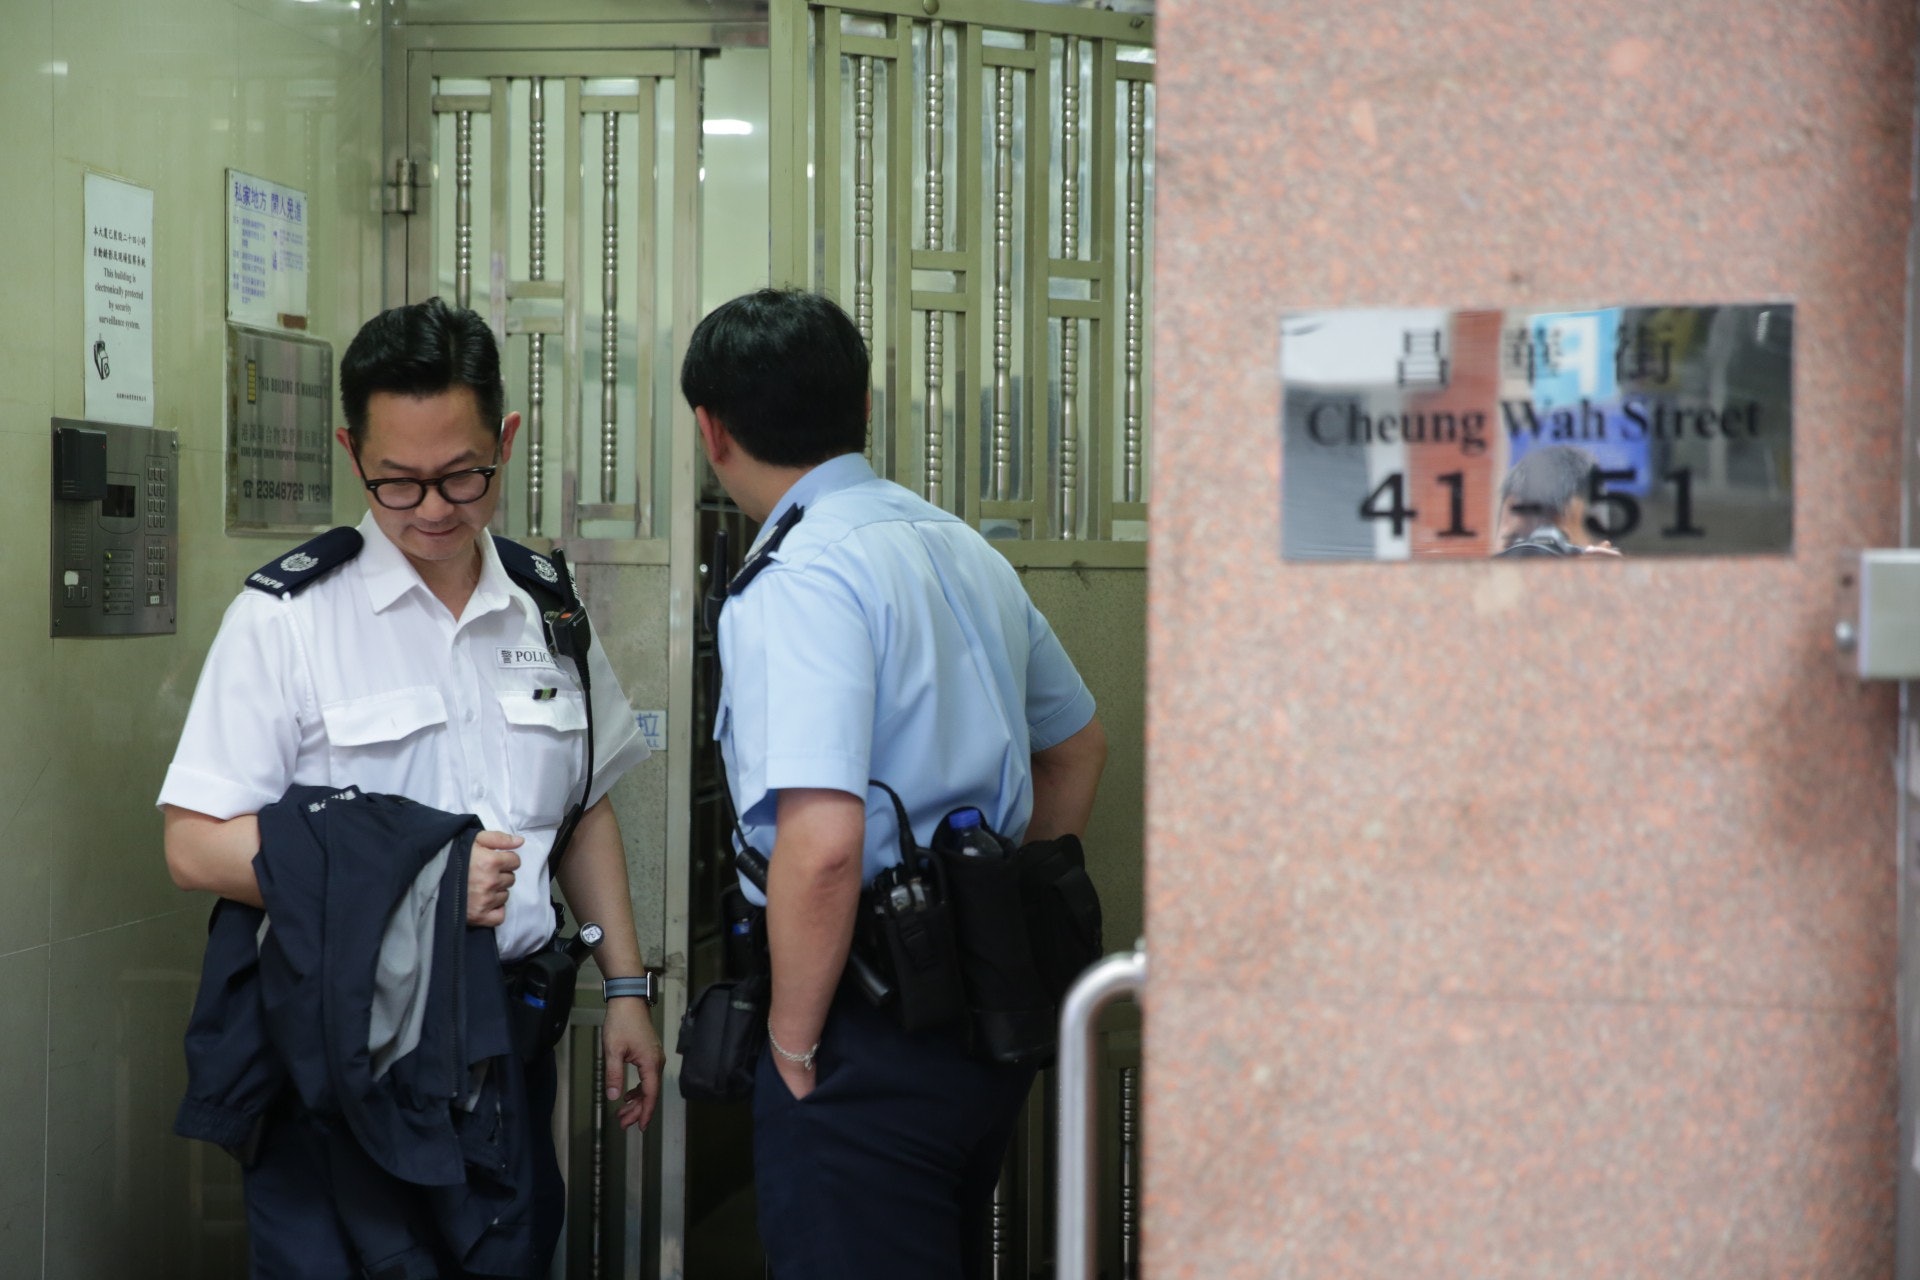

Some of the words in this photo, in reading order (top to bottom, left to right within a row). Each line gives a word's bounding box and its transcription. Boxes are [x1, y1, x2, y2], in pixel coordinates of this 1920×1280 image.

[234, 181, 267, 211] 私家地方
[103, 267, 114, 279] This
[114, 268, 132, 284] building
[132, 273, 136, 283] is
[94, 282, 125, 299] electronically
[124, 288, 144, 301] protected
[108, 299, 115, 312] by
[115, 303, 132, 315] security
[99, 315, 125, 328] surveillance
[1306, 399, 1488, 455] Cheung
[1500, 398, 1607, 441] Wah
[1621, 398, 1762, 442] Street
[515, 650, 553, 664] POLIC
